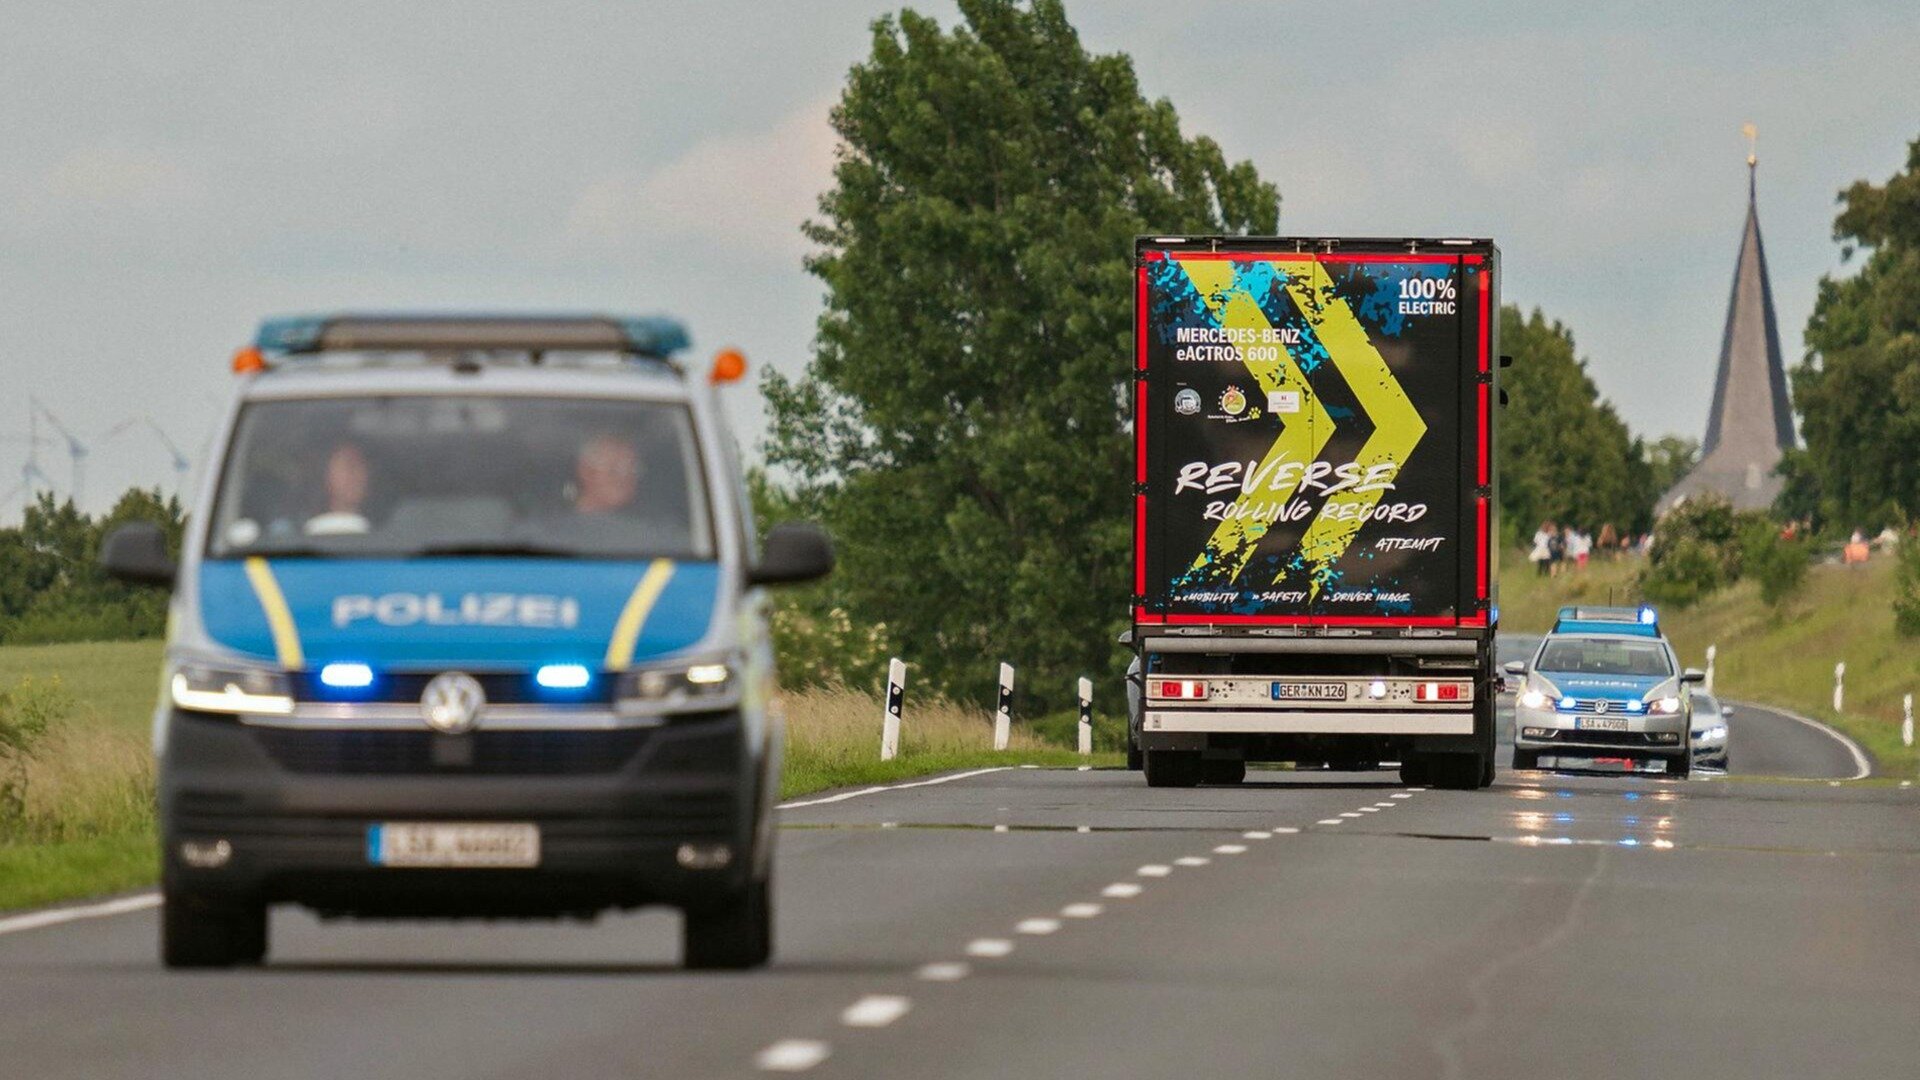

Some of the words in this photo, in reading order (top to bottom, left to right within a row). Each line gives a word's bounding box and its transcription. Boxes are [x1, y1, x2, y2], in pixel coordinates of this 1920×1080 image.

[1398, 278, 1456, 299] 100%
[1399, 302, 1456, 315] ELECTRIC
[1176, 327, 1300, 344] MERCEDES-BENZ
[1176, 346, 1243, 361] eACTROS
[1247, 346, 1278, 361] 600
[1175, 451, 1397, 496] REVERSE
[1203, 497, 1312, 522] ROLLING
[1319, 502, 1428, 523] RECORD
[1375, 537, 1445, 552] ATTEMPT
[1261, 591, 1306, 602] SAFETY
[1331, 591, 1372, 602] DRIVER
[1375, 592, 1411, 602] IMAGE
[332, 592, 580, 628] POLIZEI
[1280, 685, 1300, 697] GER
[1308, 685, 1322, 697] KN
[1324, 685, 1345, 697] 126
